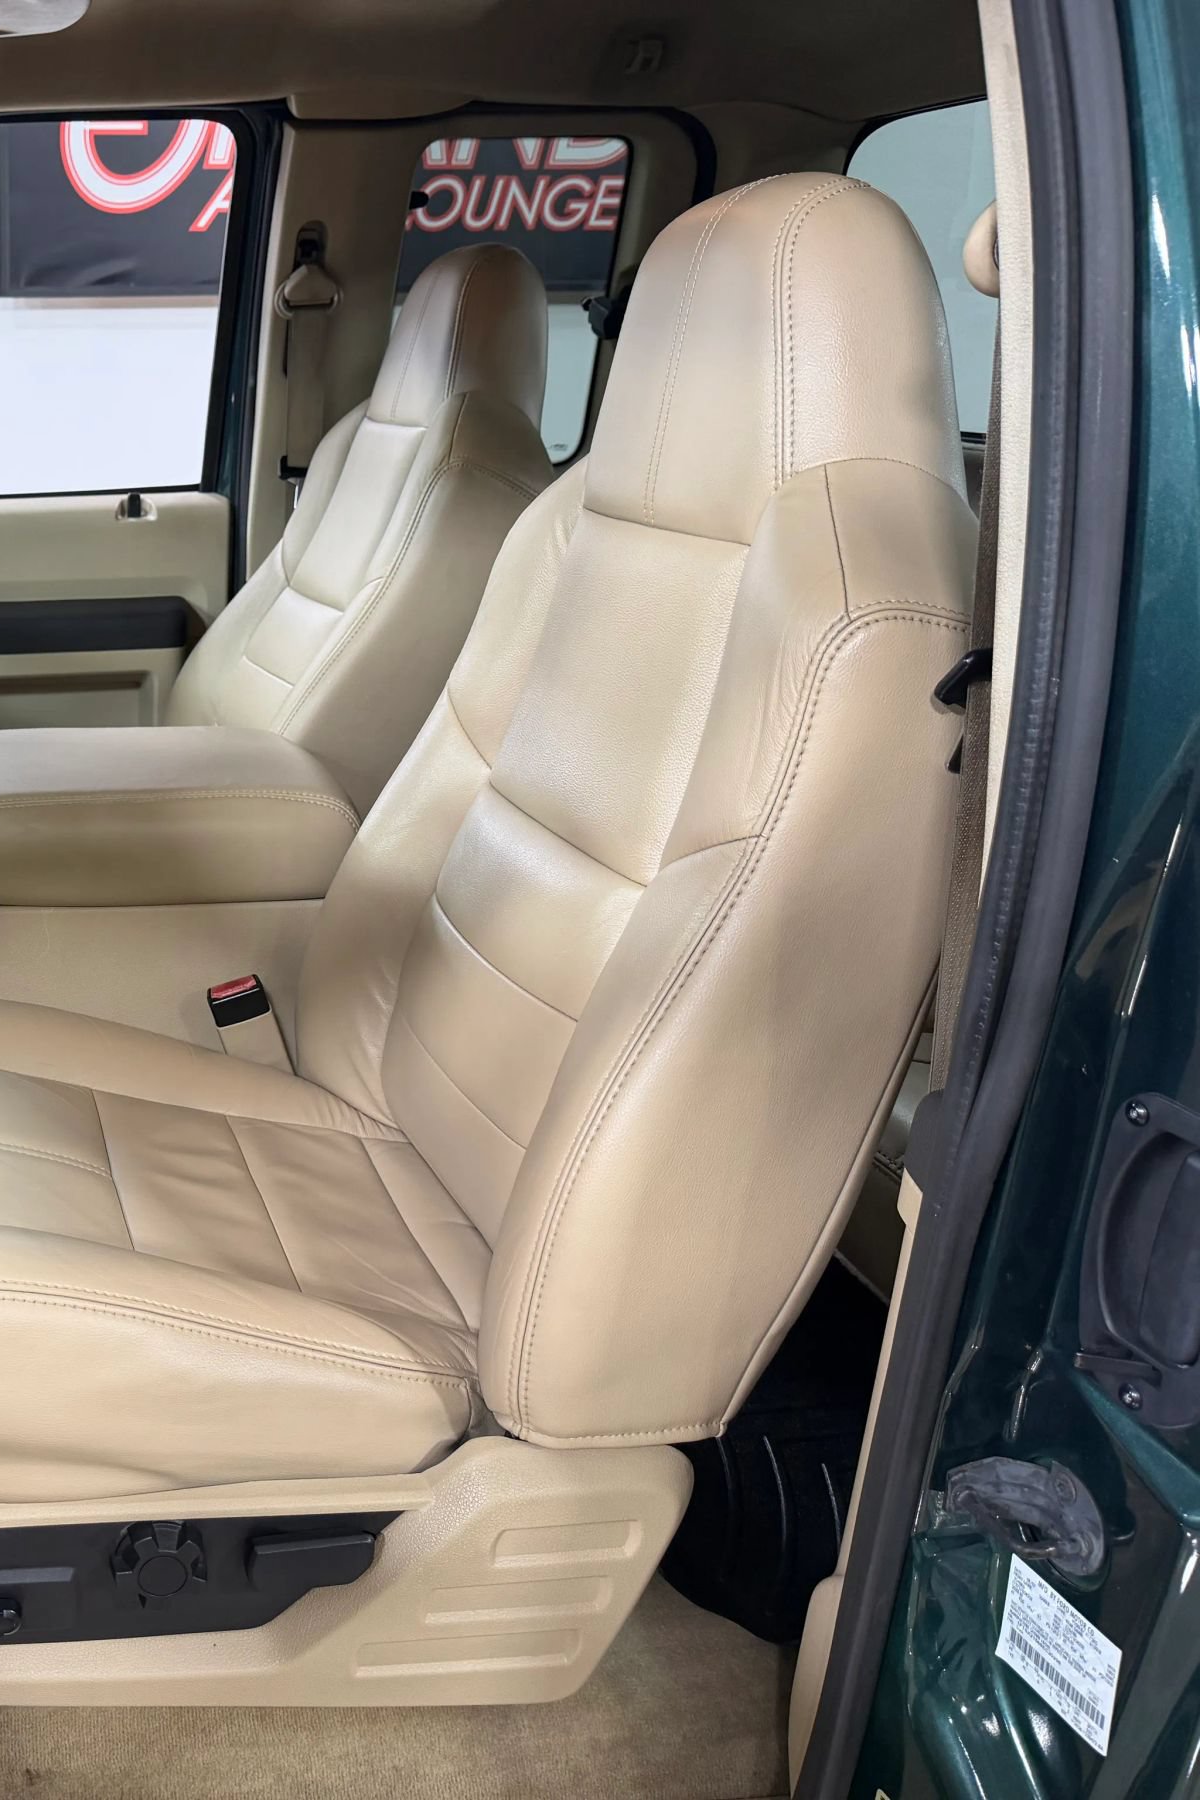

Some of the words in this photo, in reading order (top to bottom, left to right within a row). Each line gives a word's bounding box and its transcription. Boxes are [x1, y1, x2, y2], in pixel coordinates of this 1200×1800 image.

[406, 174, 625, 232] OUNGE
[1056, 1597, 1070, 1613] FORD
[1070, 1610, 1087, 1629] MOTOR
